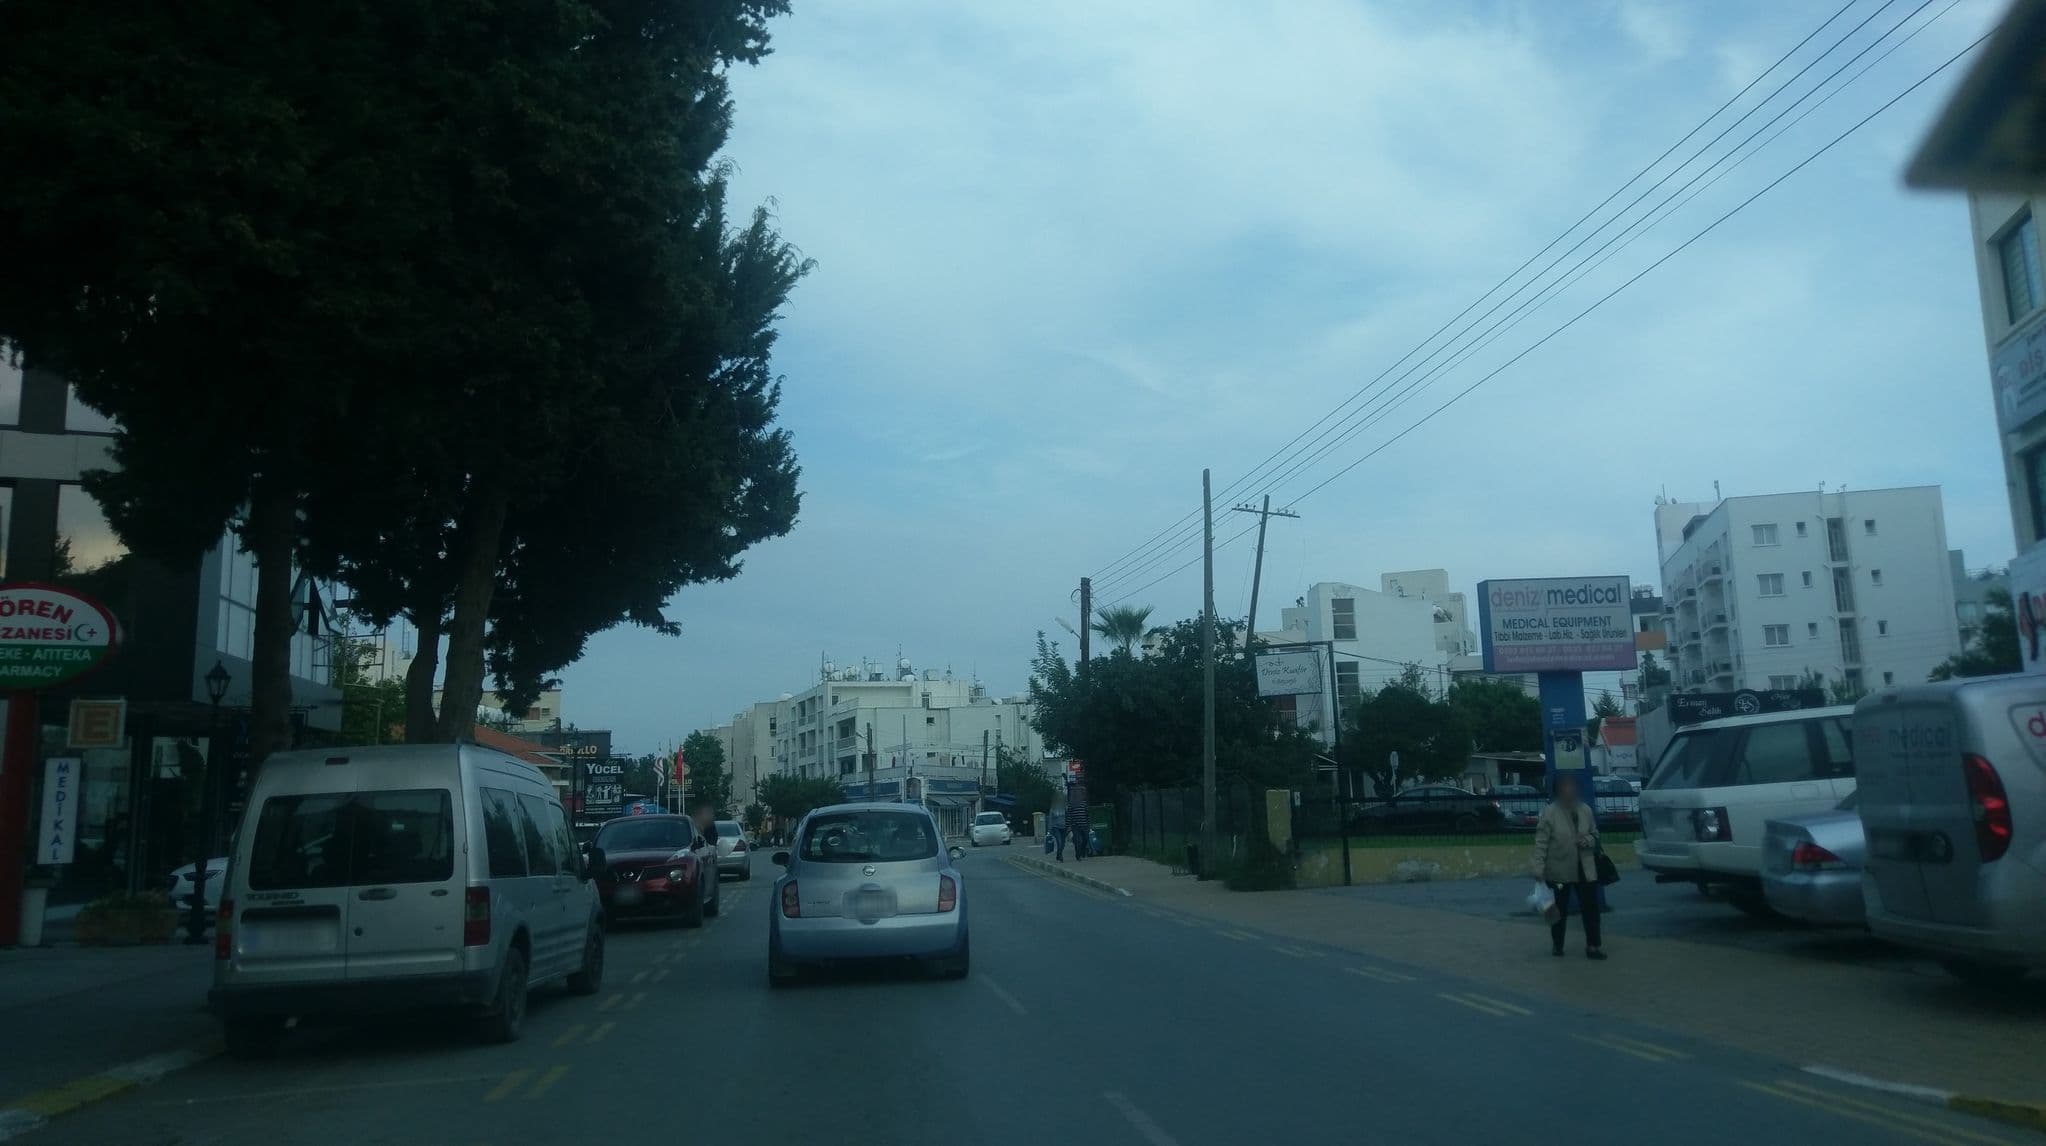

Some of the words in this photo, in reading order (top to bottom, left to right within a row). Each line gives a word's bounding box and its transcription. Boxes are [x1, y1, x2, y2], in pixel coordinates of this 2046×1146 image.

[1491, 587, 1540, 607] deniz
[1547, 583, 1623, 605] medical
[1502, 617, 1549, 630] MEDICAL
[1553, 616, 1612, 628] EQUIPMENT
[50, 761, 70, 861] MEDİKAL
